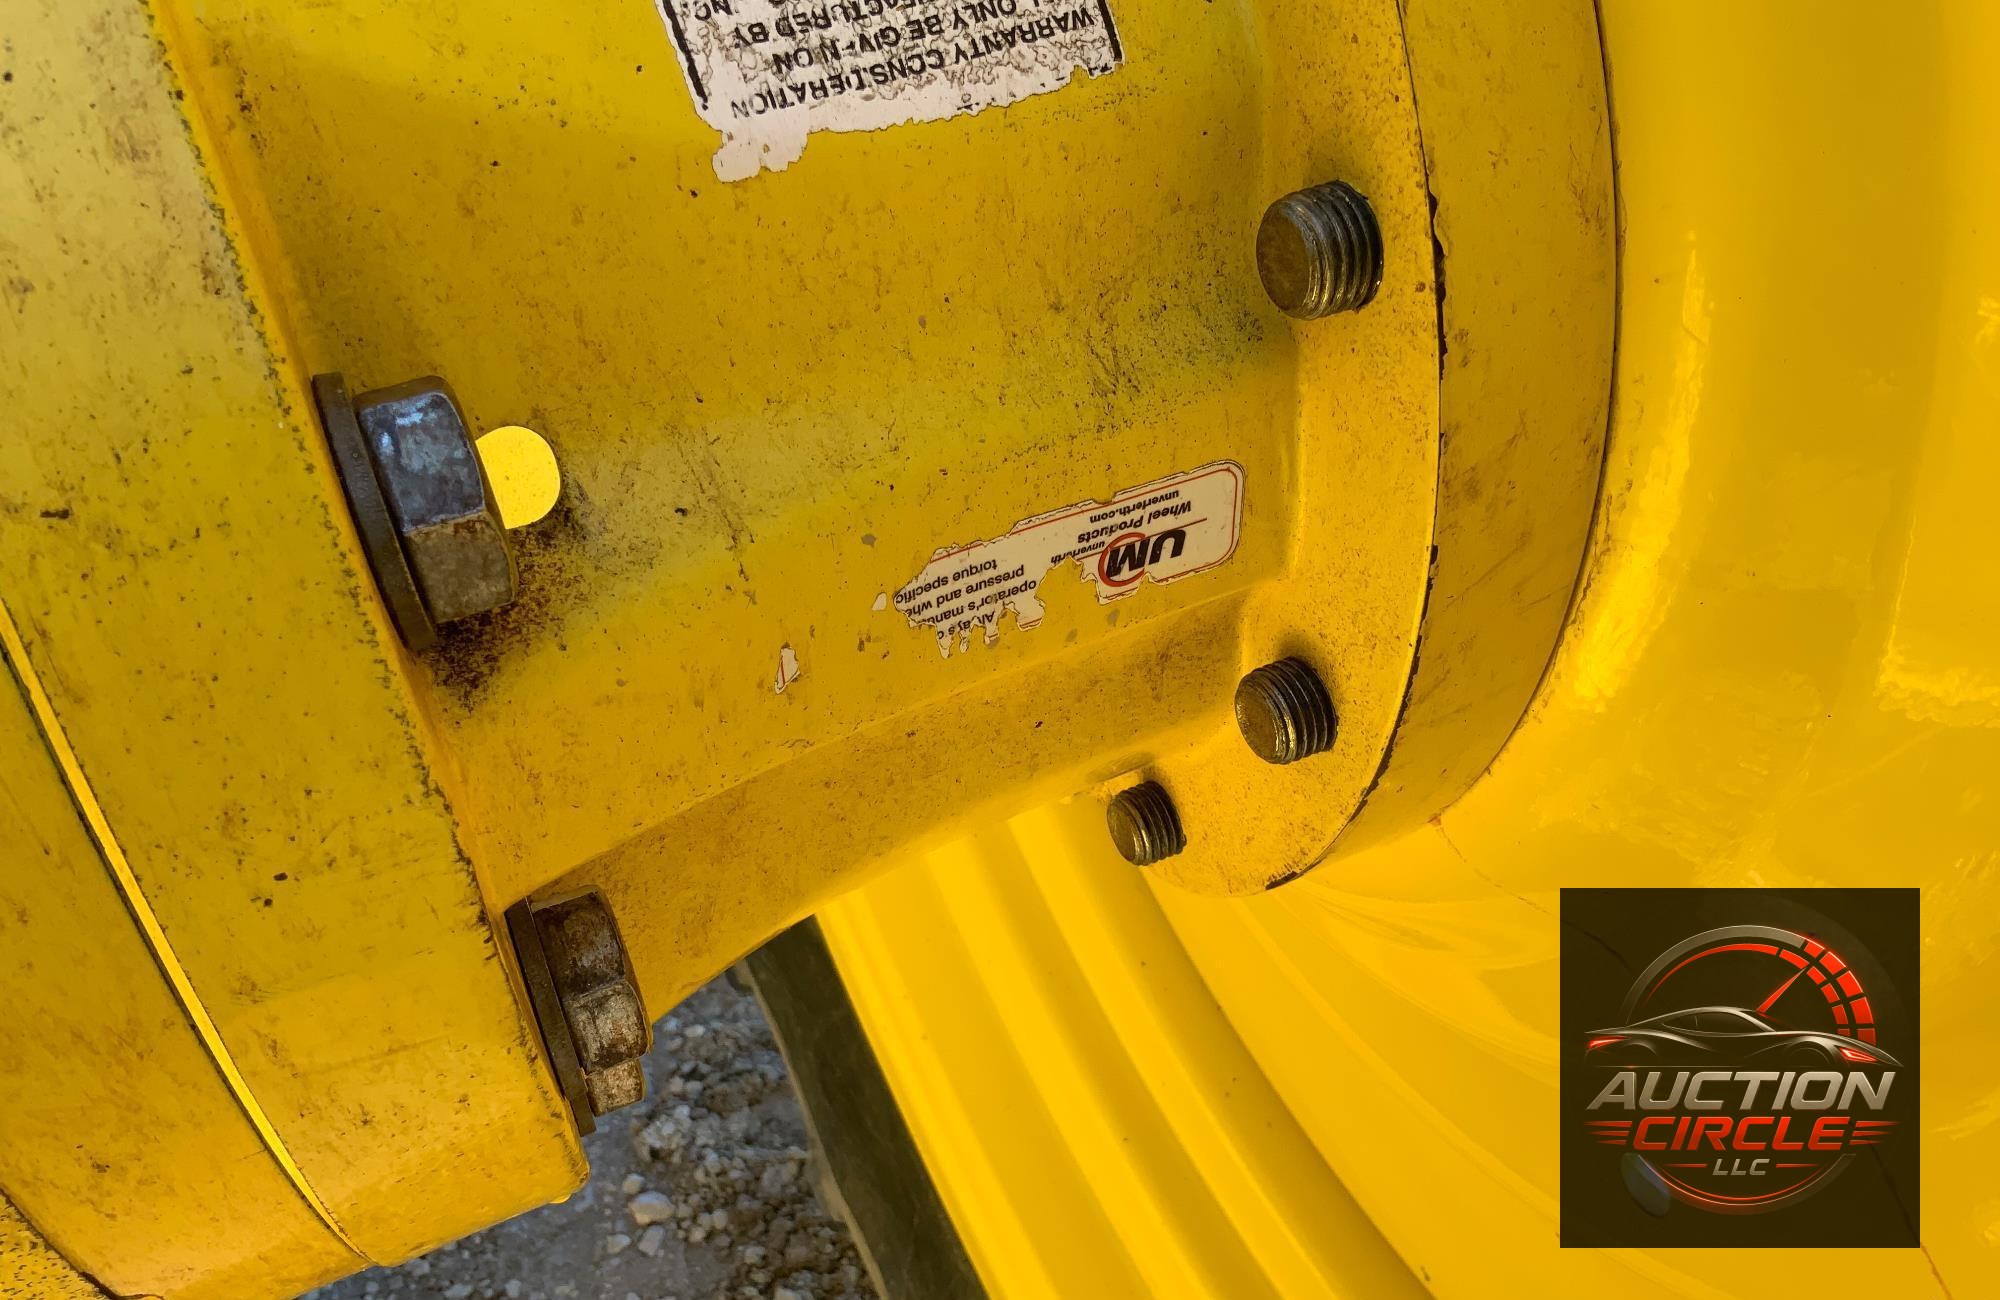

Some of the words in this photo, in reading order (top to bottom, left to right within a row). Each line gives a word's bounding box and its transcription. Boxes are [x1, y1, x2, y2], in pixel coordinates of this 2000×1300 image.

[905, 14, 945, 41] BE
[952, 0, 1017, 30] ONLY
[953, 7, 1095, 64] WARRANTY
[772, 47, 814, 75] ON
[731, 50, 945, 119] CONSDERATION
[1089, 490, 1180, 524] unverferth.com
[1147, 500, 1192, 525] Wheel
[1077, 515, 1144, 544] Products
[1105, 528, 1187, 579] UM
[952, 559, 998, 582] torque
[965, 564, 1025, 595] pressure
[936, 589, 962, 608] and
[967, 580, 1037, 611] operator's
